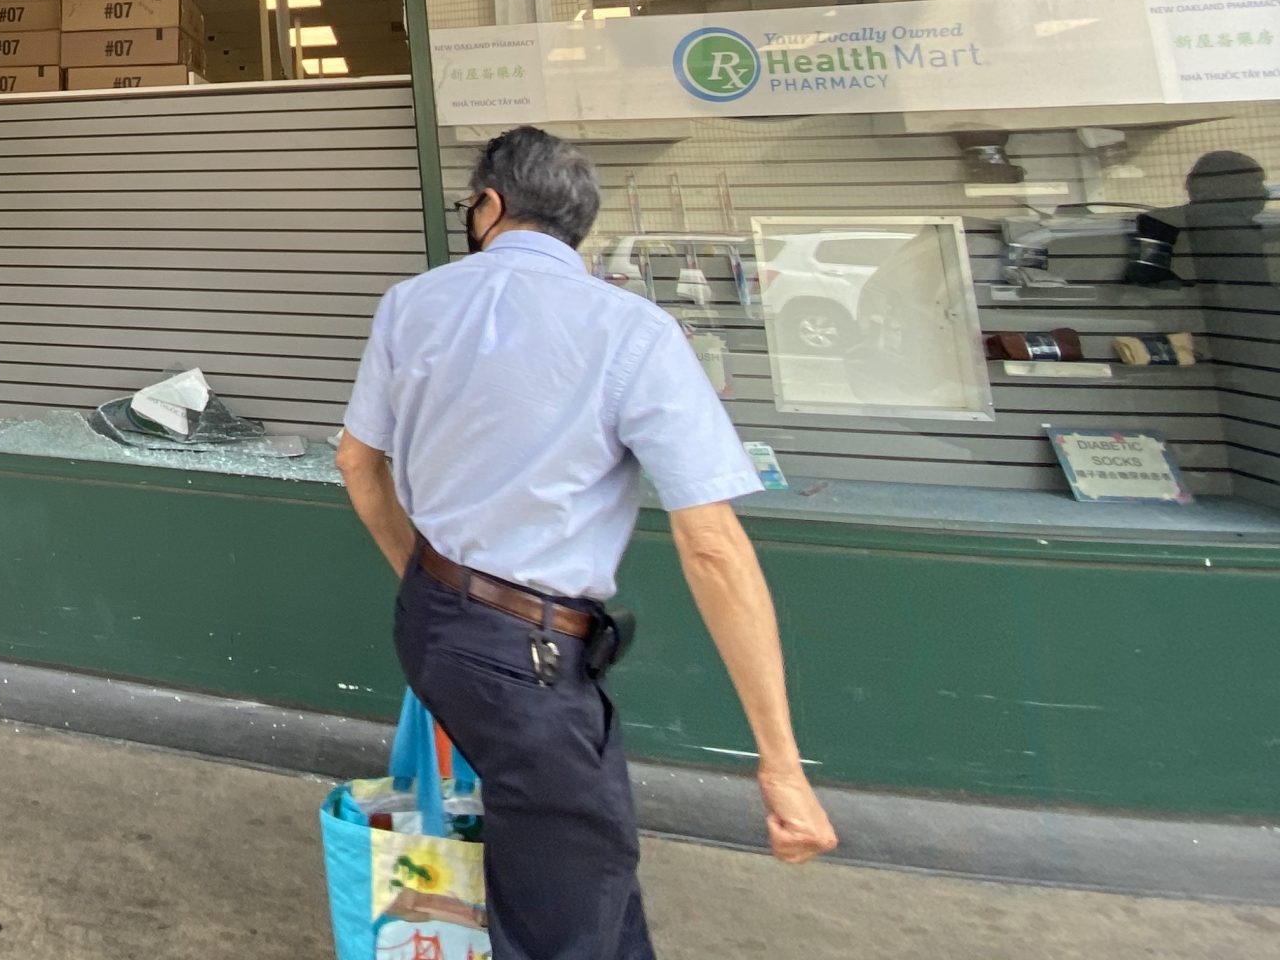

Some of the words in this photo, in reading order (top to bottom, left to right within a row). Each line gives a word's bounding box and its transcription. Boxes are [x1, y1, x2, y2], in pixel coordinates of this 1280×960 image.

[104, 2, 133, 19] #07
[1150, 6, 1174, 14] NEW
[1176, 2, 1225, 13] OAKLAND
[815, 26, 887, 44] Locally
[891, 22, 964, 40] Owned
[104, 40, 134, 57] #07
[434, 44, 453, 52] NEW
[453, 42, 491, 50] OAKLAND
[491, 40, 535, 49] PHARMACY
[112, 76, 142, 88] #07
[770, 74, 889, 92] PHARMACY
[1077, 439, 1143, 452] DIABETIC
[1091, 455, 1143, 467] SOCKS
